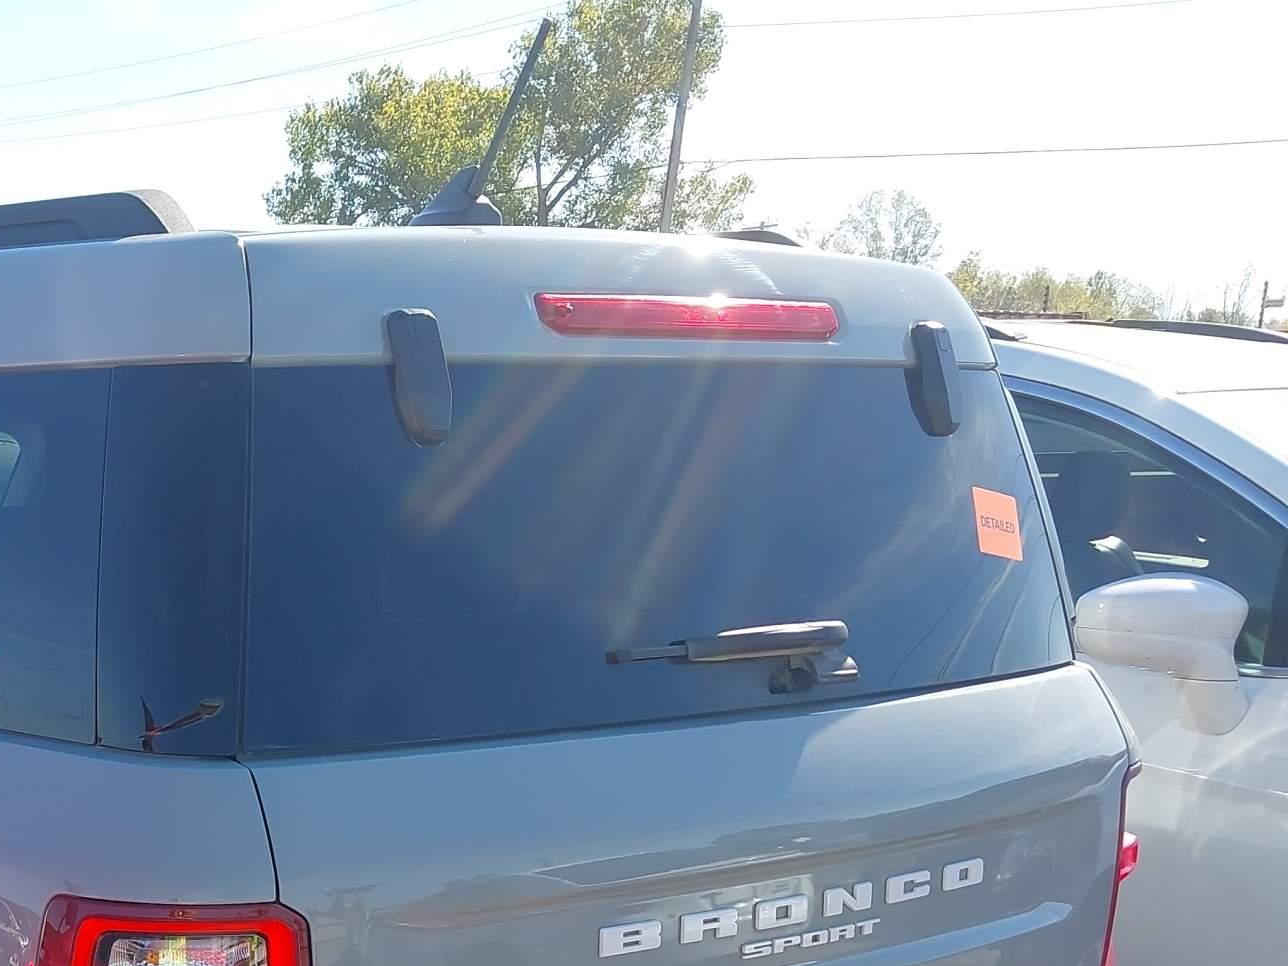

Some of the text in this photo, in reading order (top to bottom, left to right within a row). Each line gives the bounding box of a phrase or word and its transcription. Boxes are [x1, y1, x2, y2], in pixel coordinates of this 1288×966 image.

[980, 515, 1016, 535] DETAILED
[598, 857, 985, 958] BRONCO
[740, 918, 881, 960] SPORT
